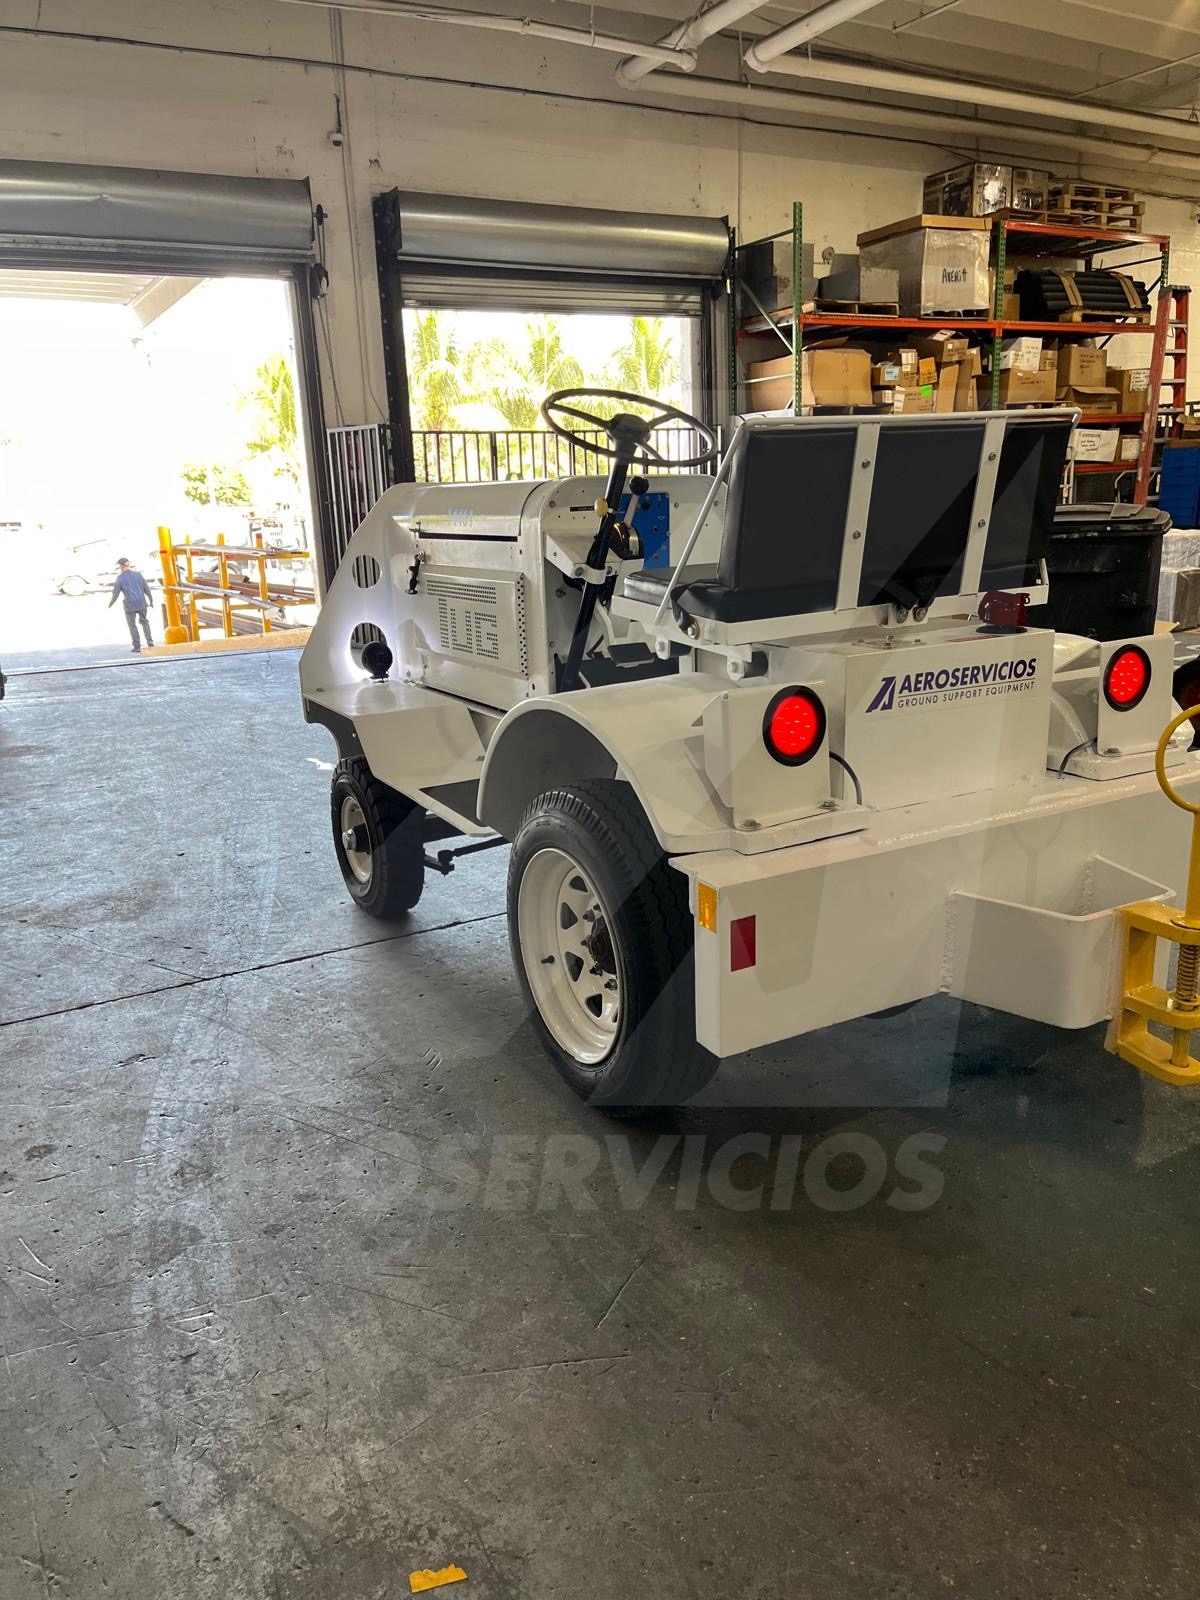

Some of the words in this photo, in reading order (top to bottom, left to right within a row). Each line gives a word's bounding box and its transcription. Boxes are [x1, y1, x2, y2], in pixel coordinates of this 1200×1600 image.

[898, 658, 1037, 695] AEROSERVICIOS
[897, 694, 939, 709] GROUND
[942, 688, 982, 702] SUPPORT
[985, 681, 1035, 696] EQUIPMENT
